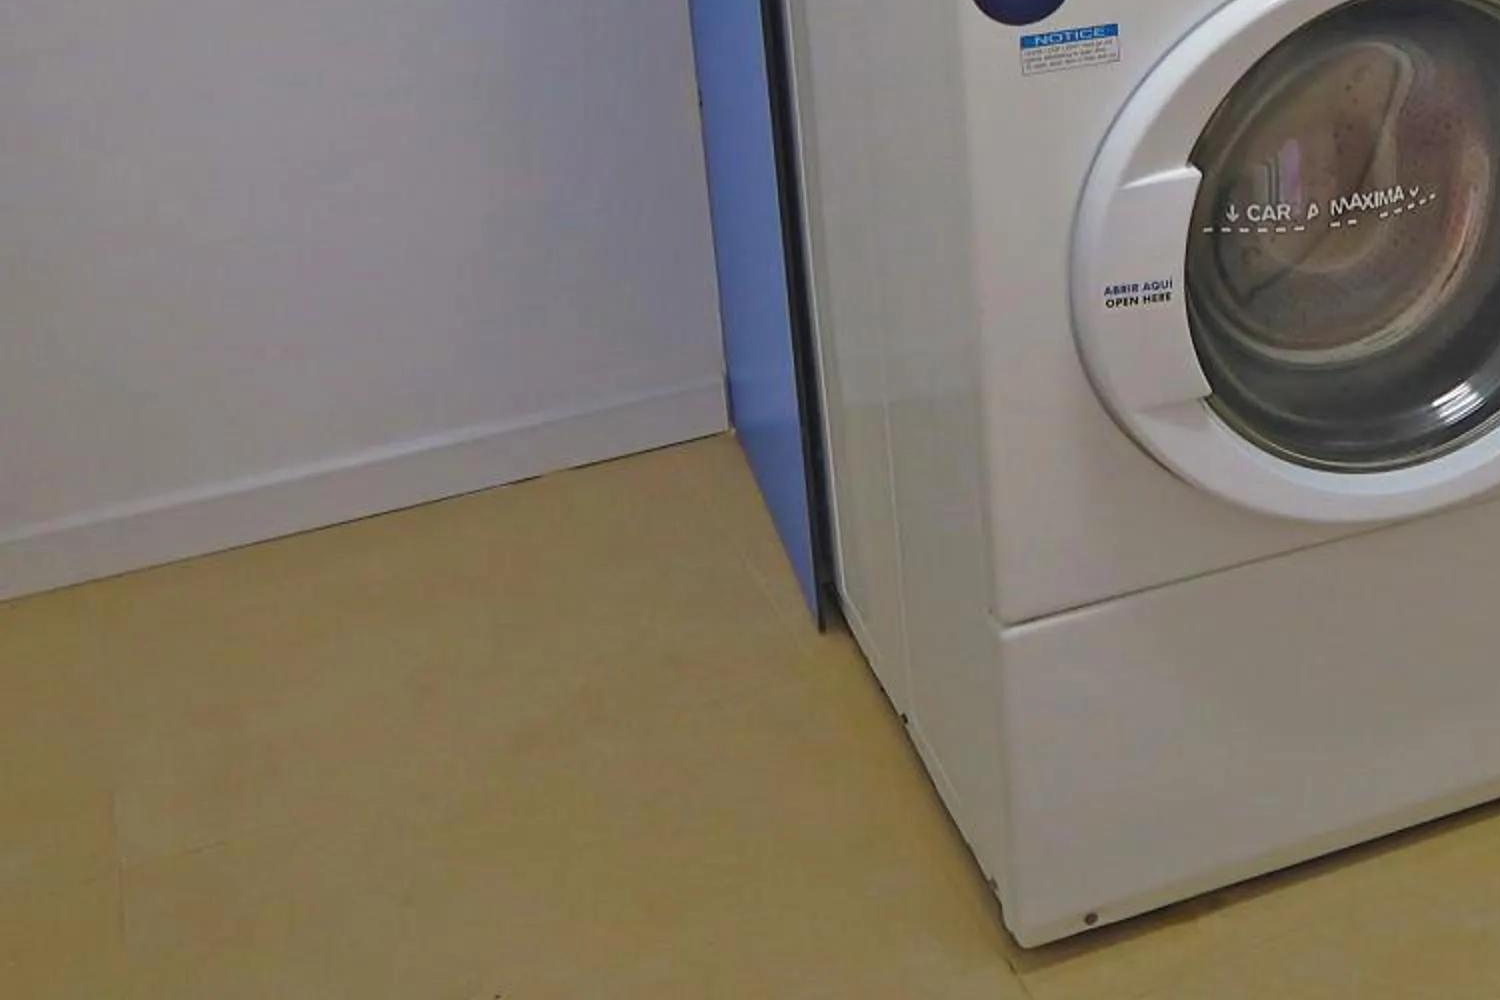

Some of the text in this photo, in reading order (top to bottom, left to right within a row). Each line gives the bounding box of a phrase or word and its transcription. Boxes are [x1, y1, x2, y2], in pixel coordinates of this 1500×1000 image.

[1034, 27, 1105, 45] NOTICE
[1247, 185, 1405, 222] CARA MAXIMA
[1103, 283, 1139, 296] ABRIR
[1105, 291, 1171, 308] OPEN HERE
